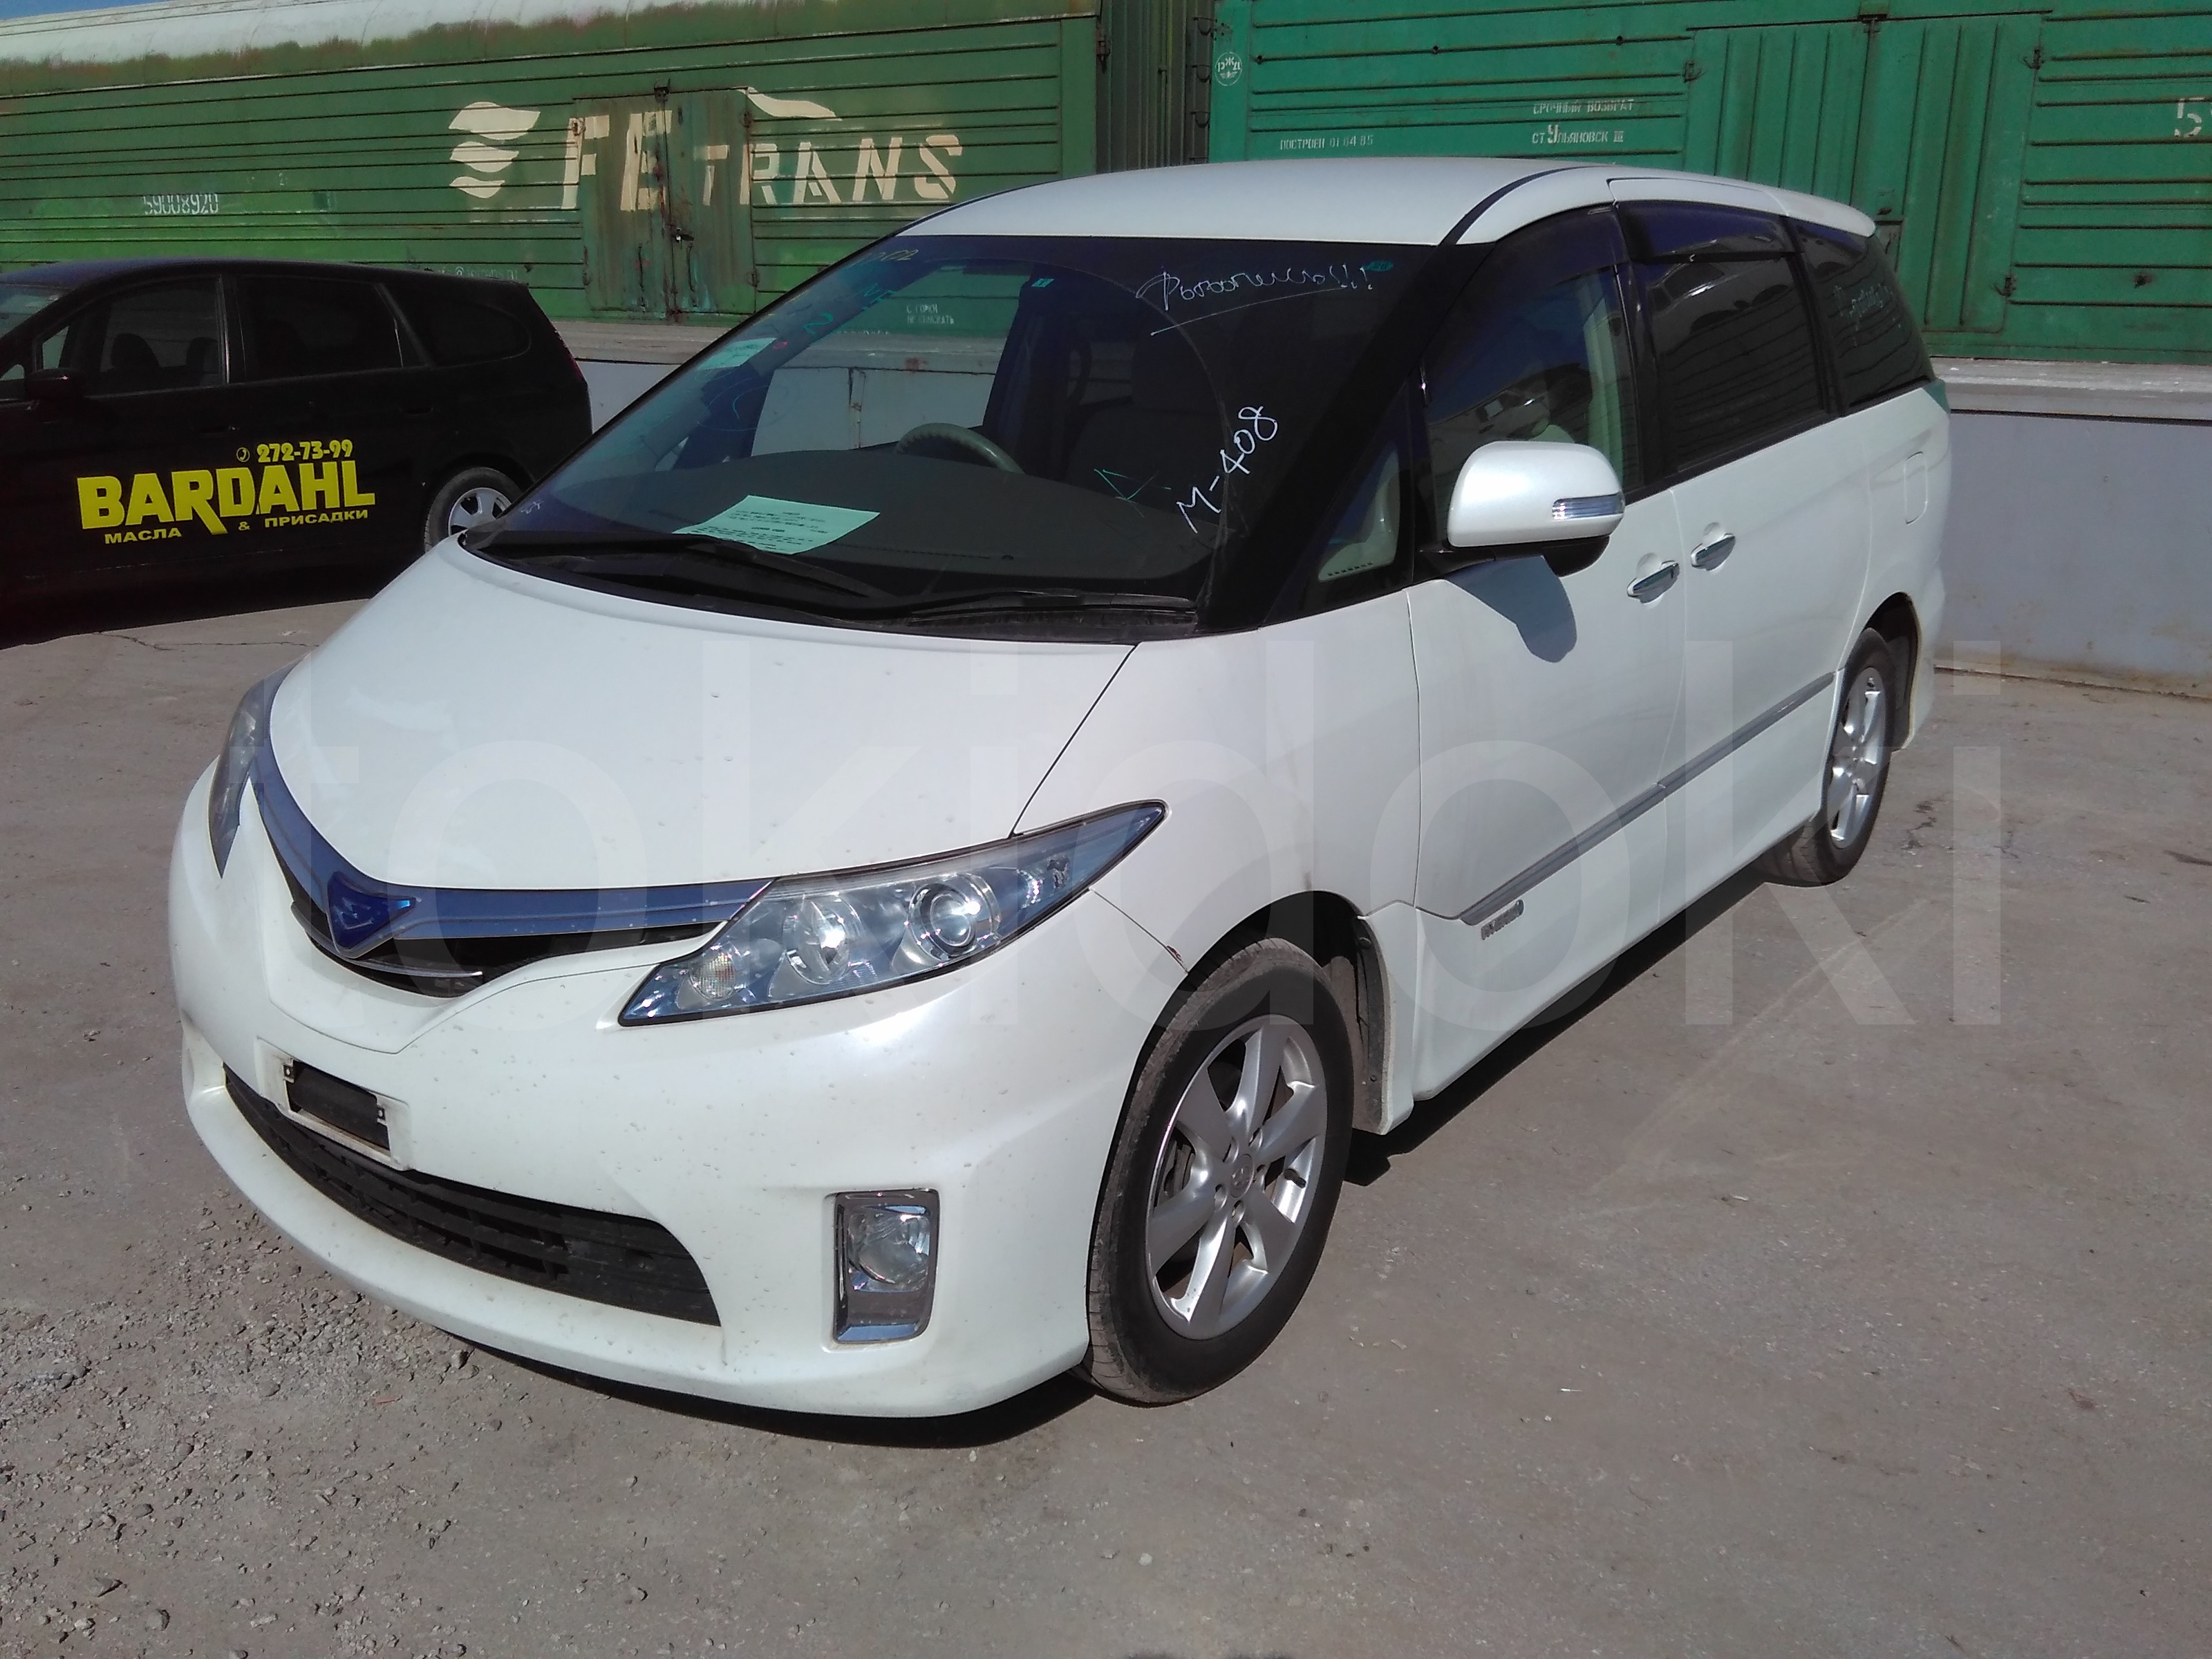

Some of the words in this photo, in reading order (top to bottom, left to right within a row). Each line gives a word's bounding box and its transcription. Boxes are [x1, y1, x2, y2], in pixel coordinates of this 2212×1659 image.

[1533, 100, 1582, 114] СРОЧНЫЙ
[1587, 99, 1634, 113] ВОЗВРАТ
[1280, 138, 1325, 150] ПОСТРОЕН
[142, 192, 219, 215] 59008920
[256, 440, 353, 462] 272-73-99
[77, 460, 375, 535] BARDAHL
[104, 527, 182, 544] МАСЛА
[238, 521, 250, 531] &
[264, 509, 368, 527] ПРИСАДКИ
